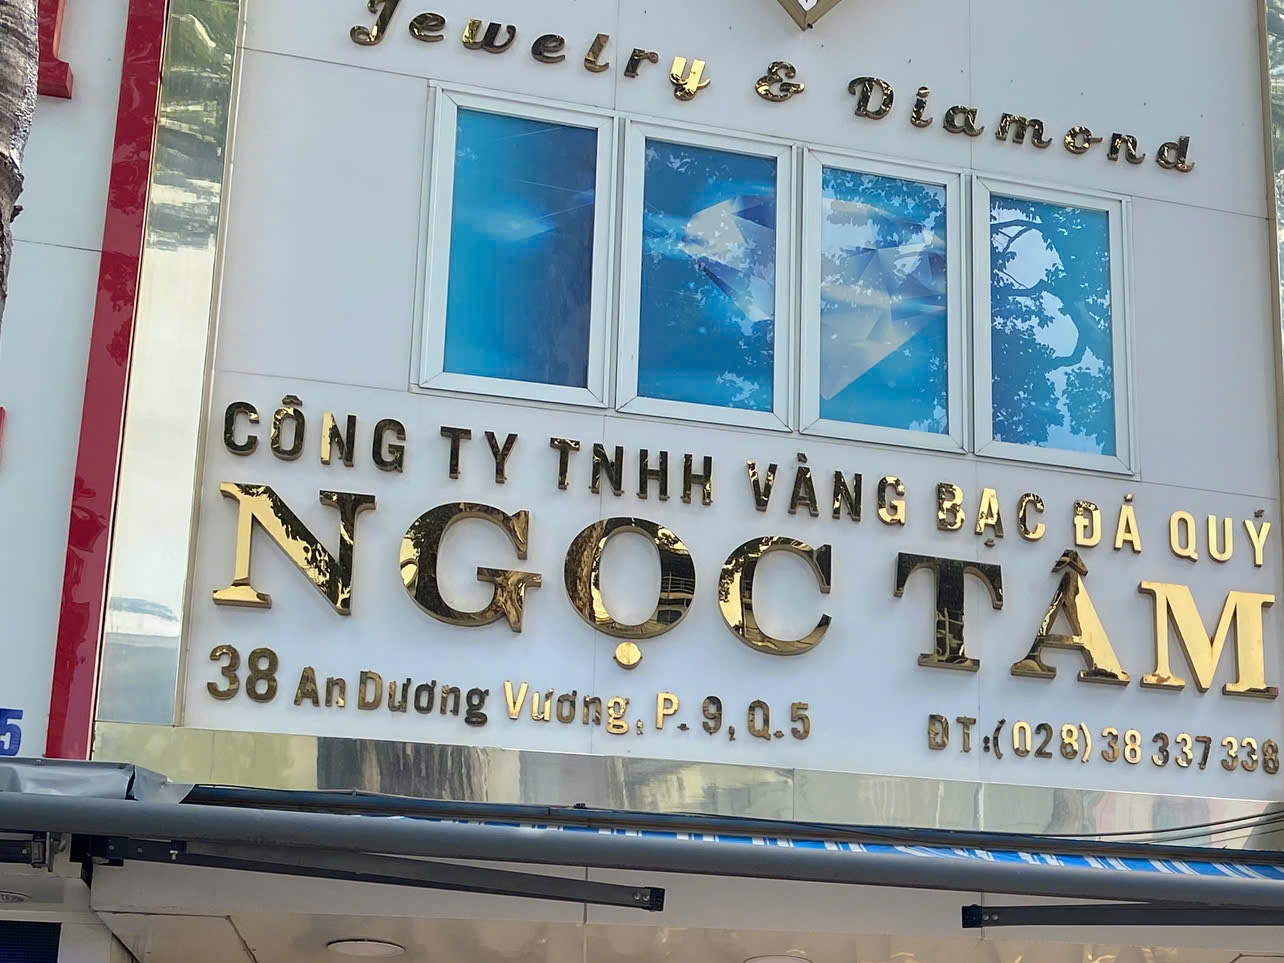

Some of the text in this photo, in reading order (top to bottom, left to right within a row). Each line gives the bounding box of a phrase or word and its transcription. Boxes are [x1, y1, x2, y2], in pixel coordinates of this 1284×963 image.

[350, 0, 1196, 172] Jewelry & Diamond
[223, 394, 1272, 567] CÔNG TY TNHH VÀNG BẠC ĐÁ QUÝ
[212, 481, 1279, 699] NGỌC TÂM
[206, 645, 279, 703] 38
[293, 665, 347, 709] An
[357, 670, 489, 728] Dương
